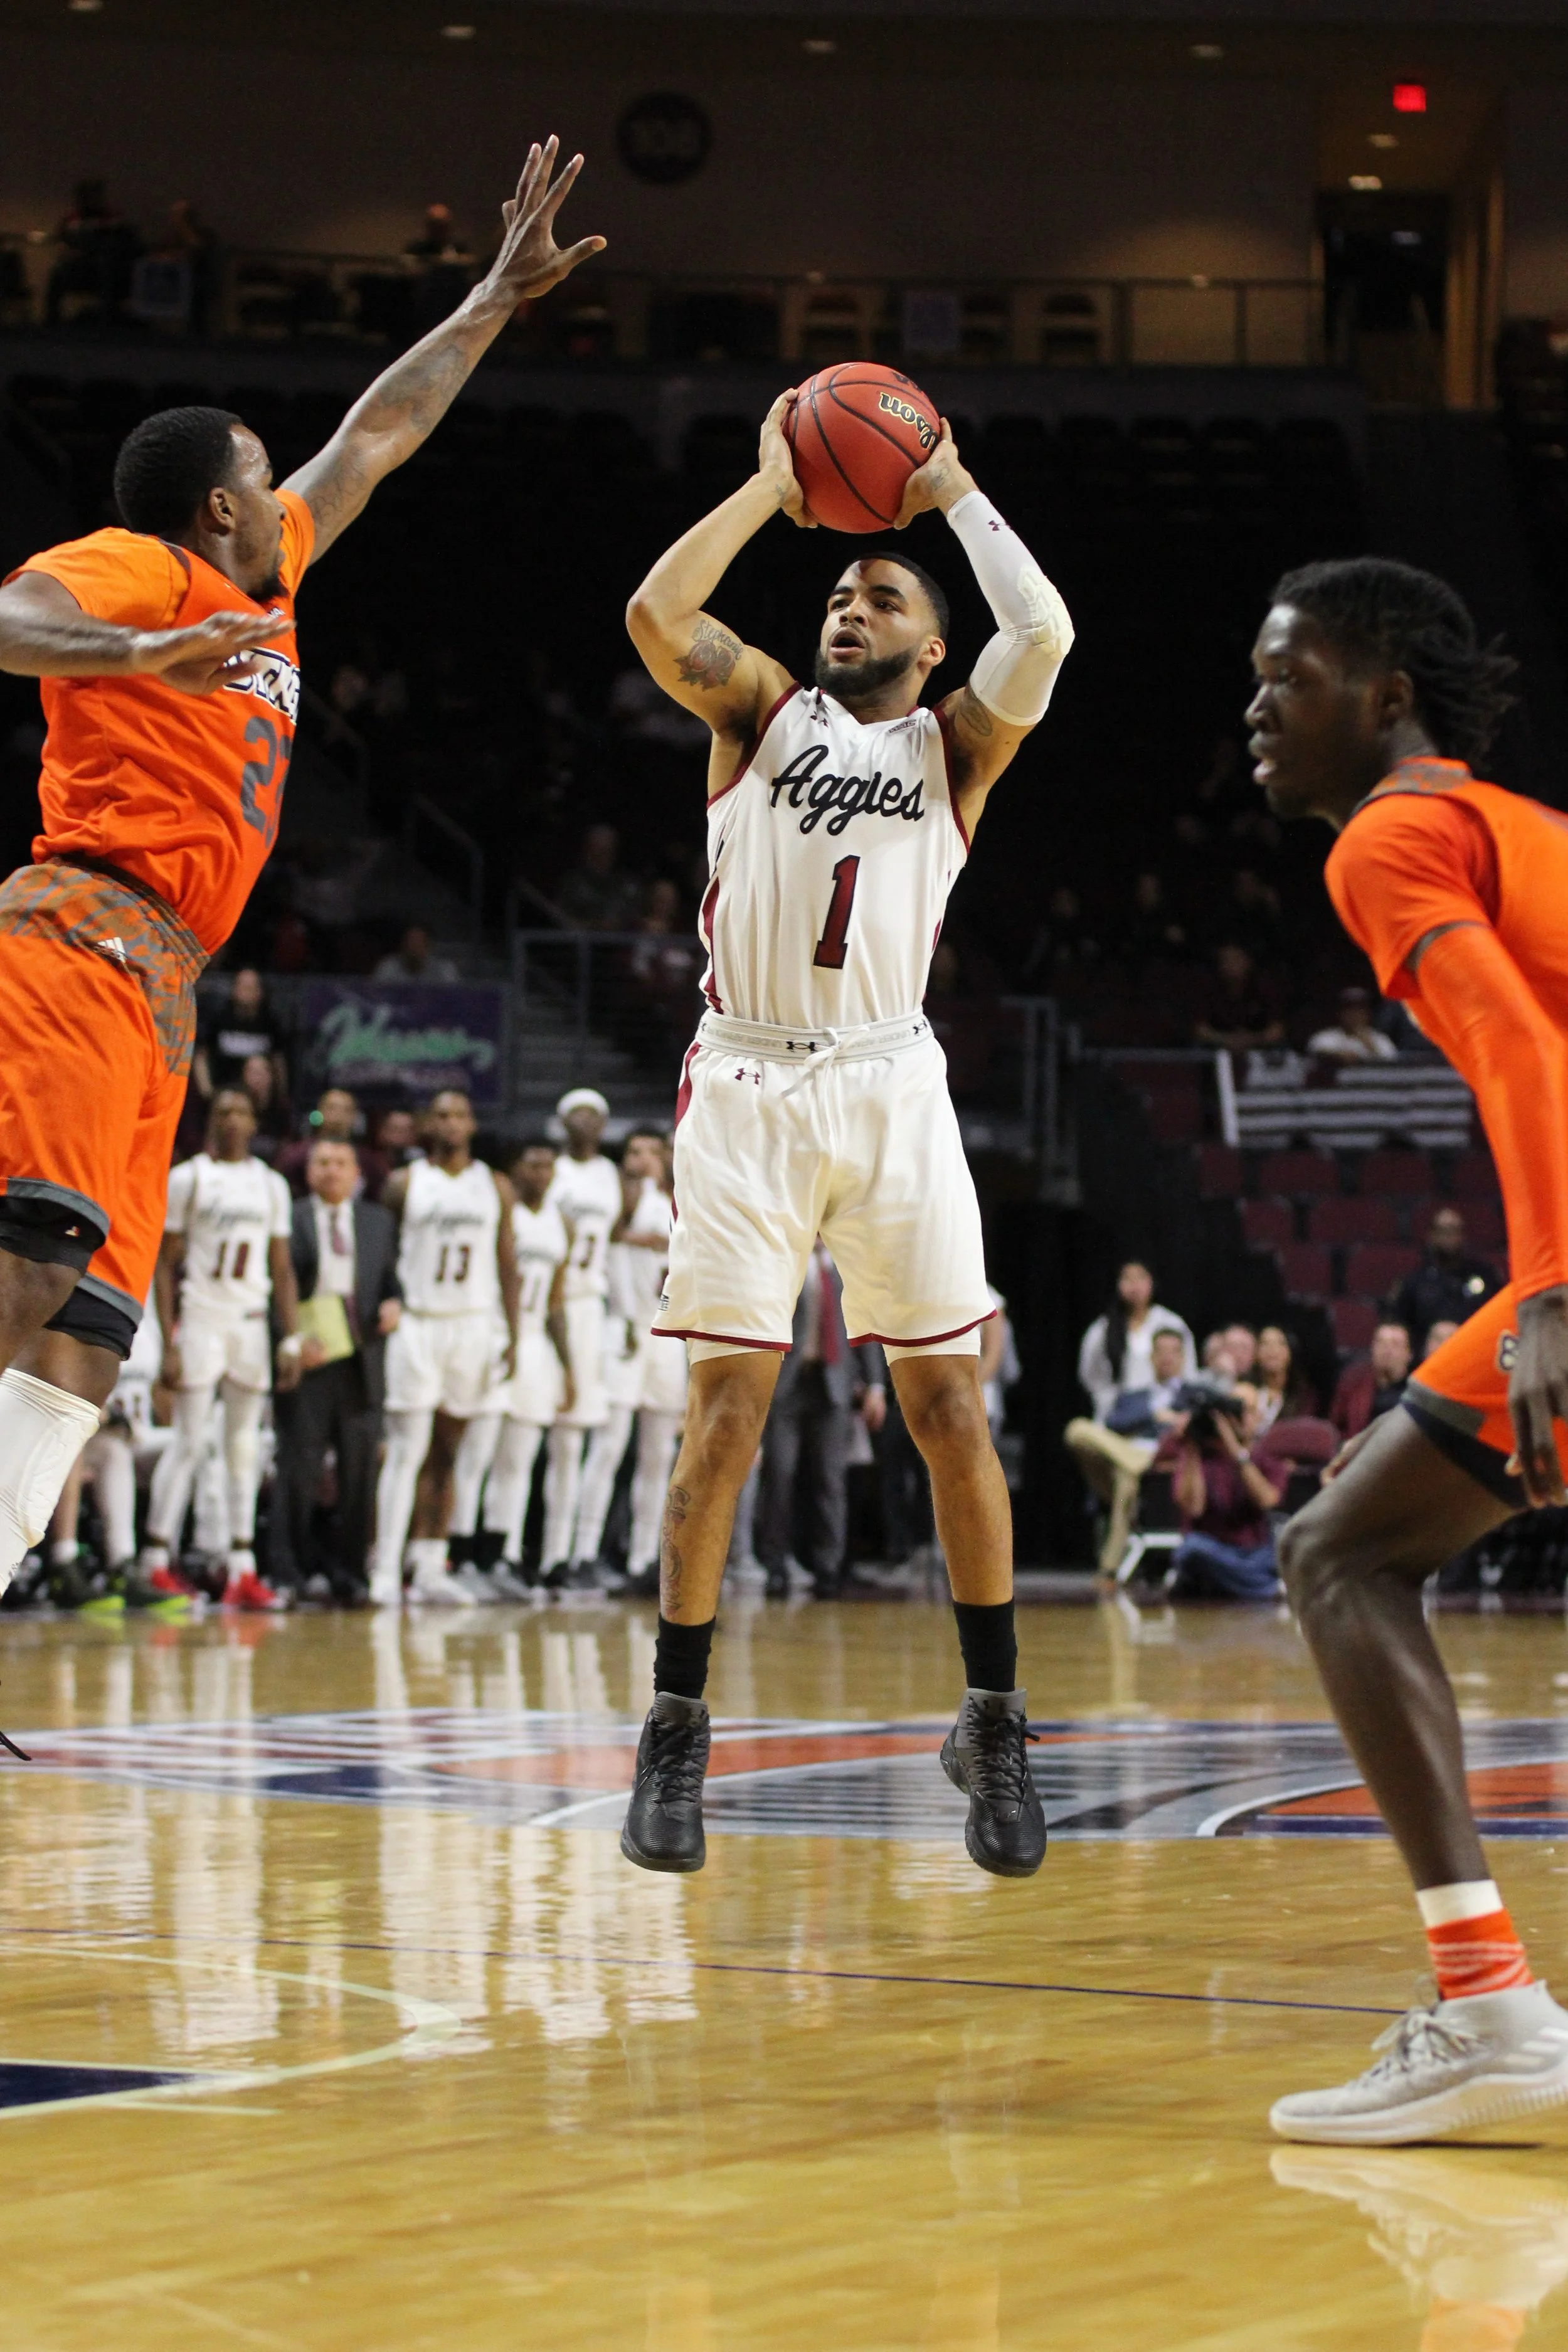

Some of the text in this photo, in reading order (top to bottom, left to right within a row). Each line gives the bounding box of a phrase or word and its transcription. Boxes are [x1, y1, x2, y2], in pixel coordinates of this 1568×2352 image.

[879, 392, 940, 450] lson
[771, 744, 925, 835] Aggies
[813, 854, 861, 969] 1
[435, 1243, 471, 1283] 13
